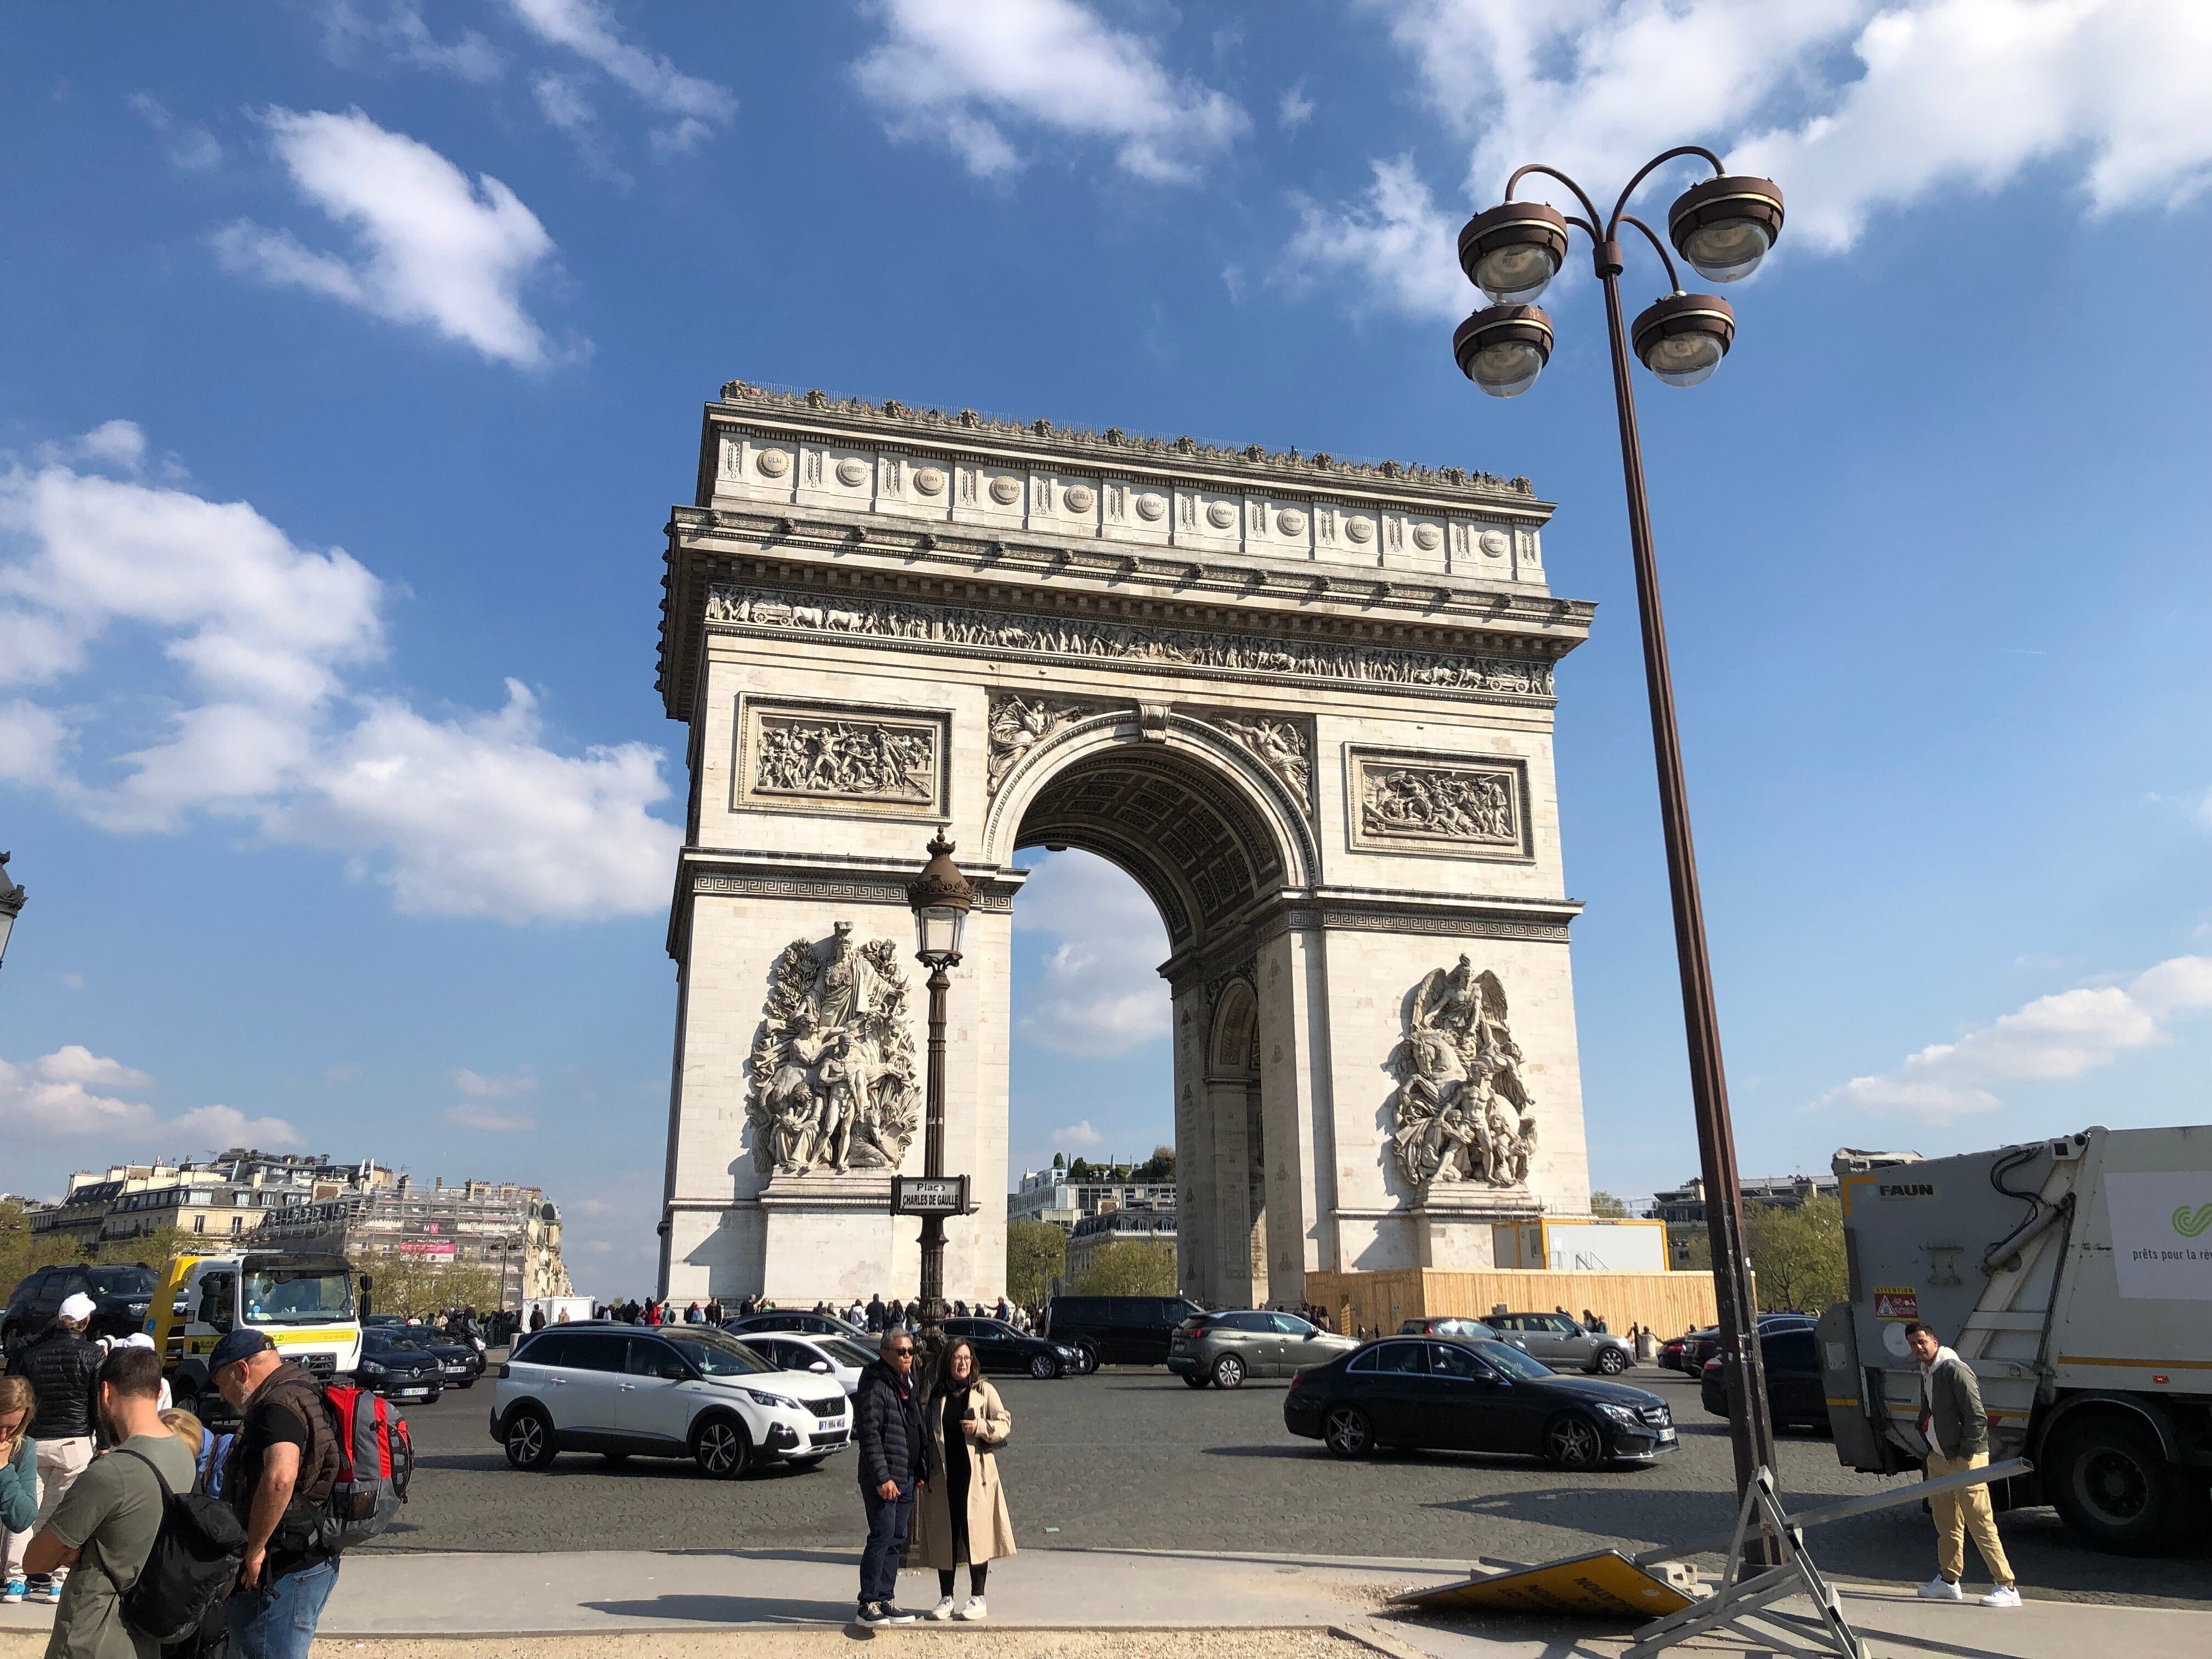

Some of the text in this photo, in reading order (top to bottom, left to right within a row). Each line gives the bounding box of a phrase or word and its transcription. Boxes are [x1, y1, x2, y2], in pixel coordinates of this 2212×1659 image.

[1880, 1184, 1934, 1196] FAUN
[903, 1194, 958, 1205] CHARLES DE GAULLE
[2132, 1248, 2158, 1261] prêts
[2161, 1250, 2183, 1262] pour
[2186, 1249, 2197, 1260] la
